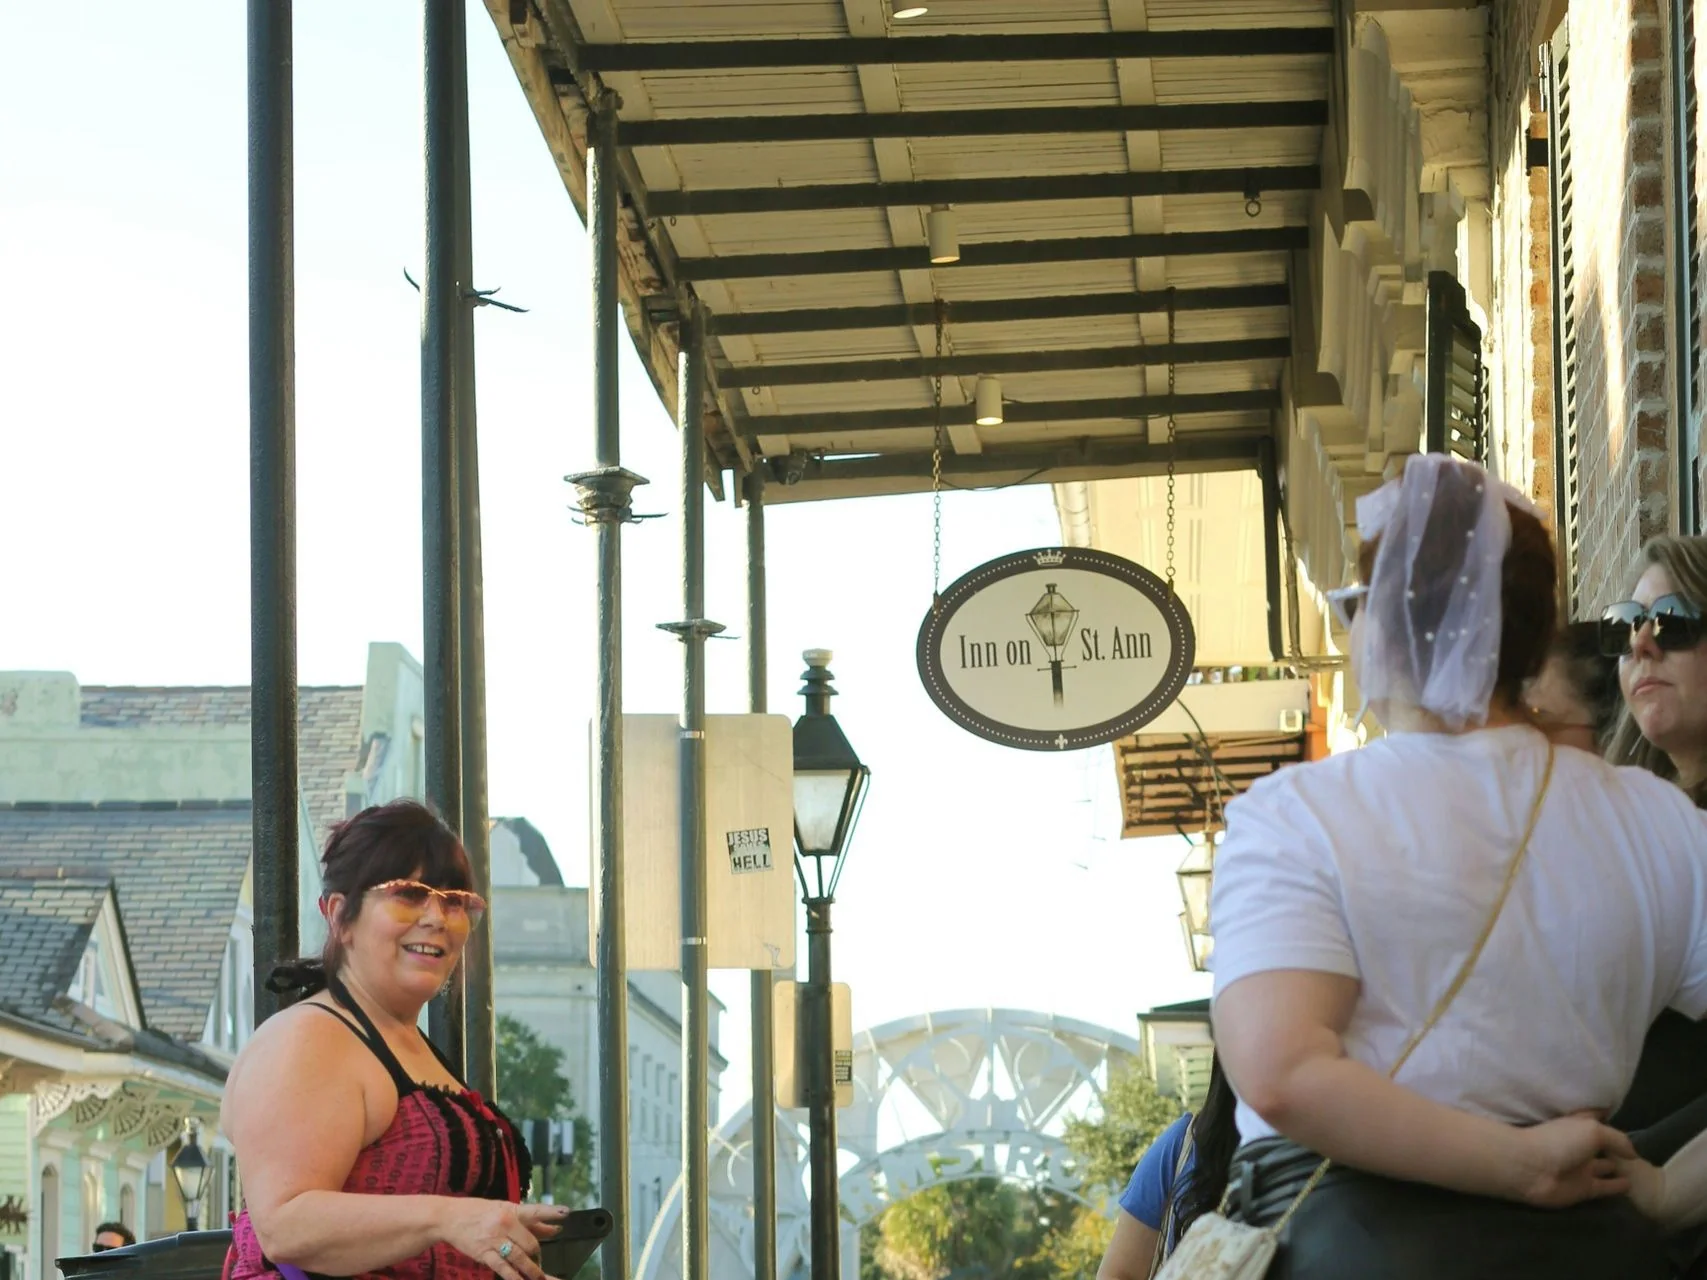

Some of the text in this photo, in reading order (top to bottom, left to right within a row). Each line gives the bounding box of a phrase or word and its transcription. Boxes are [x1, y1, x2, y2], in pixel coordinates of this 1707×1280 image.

[959, 626, 1153, 669] Inn on St. Ann
[728, 829, 768, 846] JESUS
[733, 853, 771, 870] HELL
